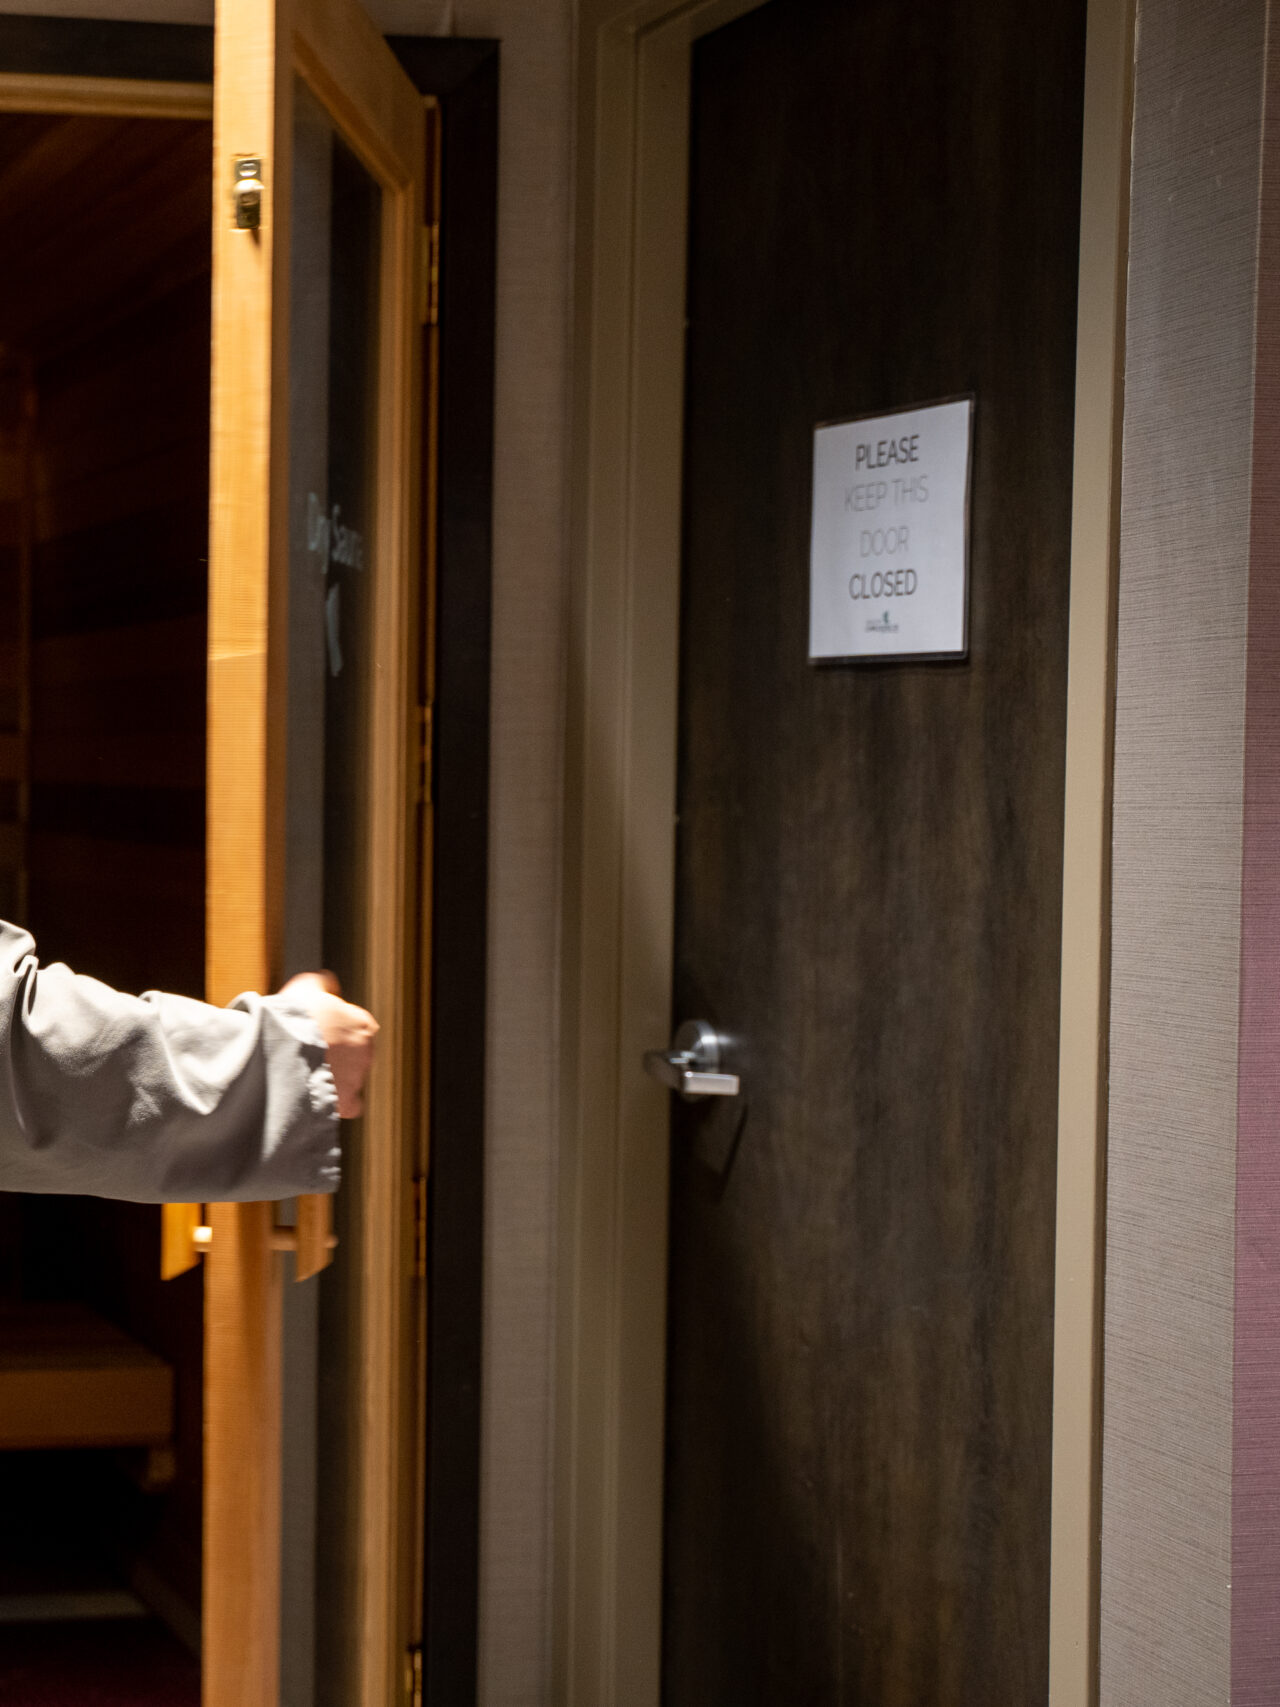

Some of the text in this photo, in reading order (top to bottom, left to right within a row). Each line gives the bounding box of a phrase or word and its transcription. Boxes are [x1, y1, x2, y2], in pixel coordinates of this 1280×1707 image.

[856, 434, 919, 470] PLEASE
[845, 474, 929, 511] KEEP THIS
[861, 526, 909, 557] DOOR
[848, 569, 917, 600] CLOSED
